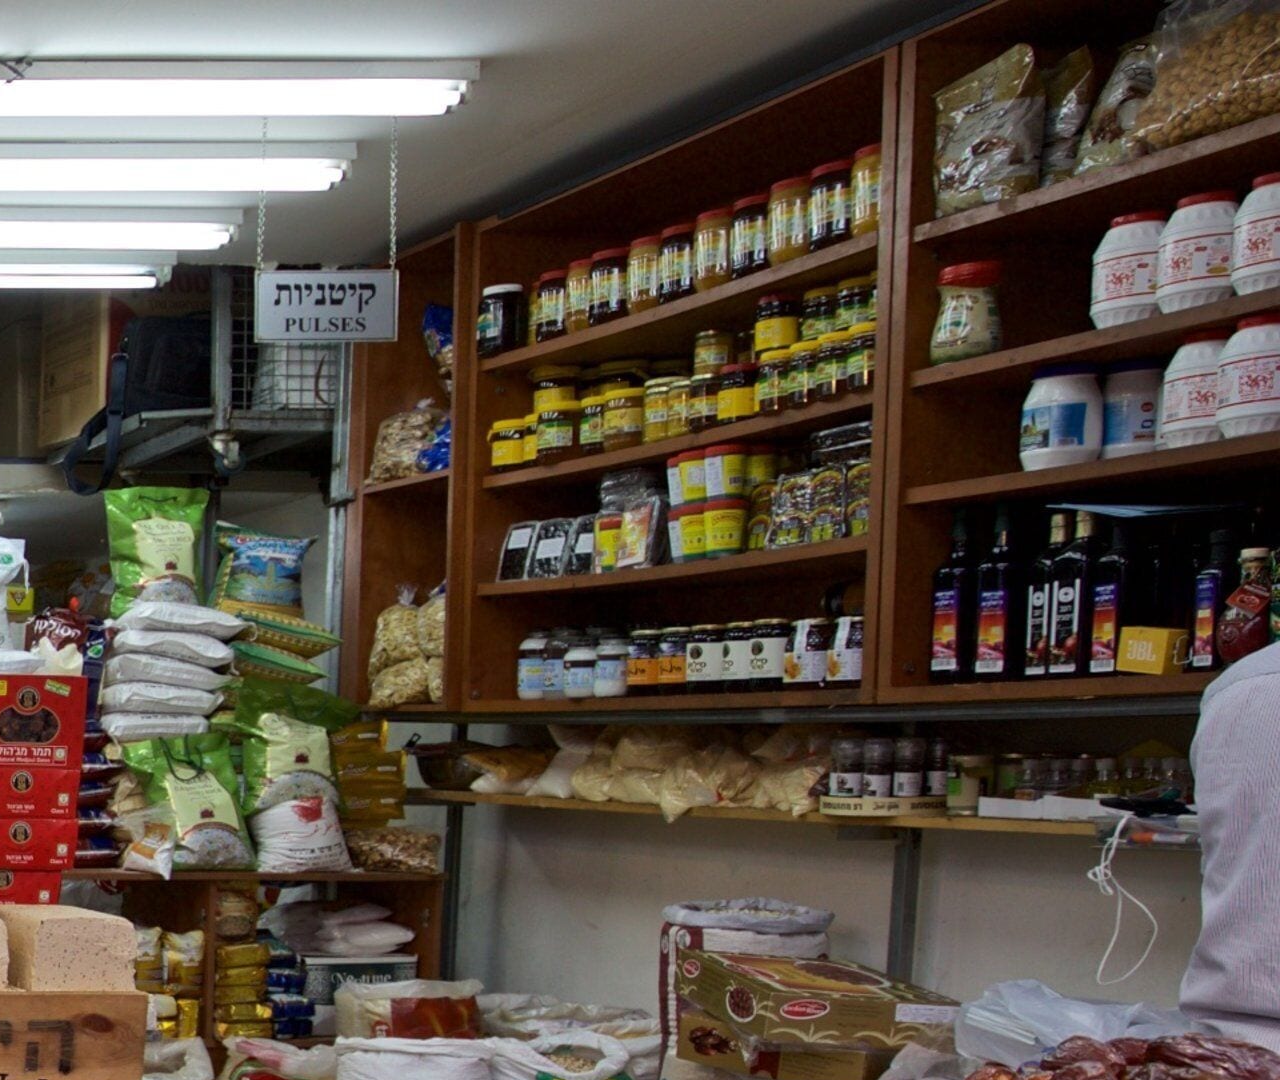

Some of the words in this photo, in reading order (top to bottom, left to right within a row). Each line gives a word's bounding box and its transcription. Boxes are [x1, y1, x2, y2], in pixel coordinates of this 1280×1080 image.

[274, 283, 377, 313] קיטניות
[285, 317, 367, 333] PULSES
[1127, 640, 1157, 662] JBL
[31, 747, 52, 757] תמר
